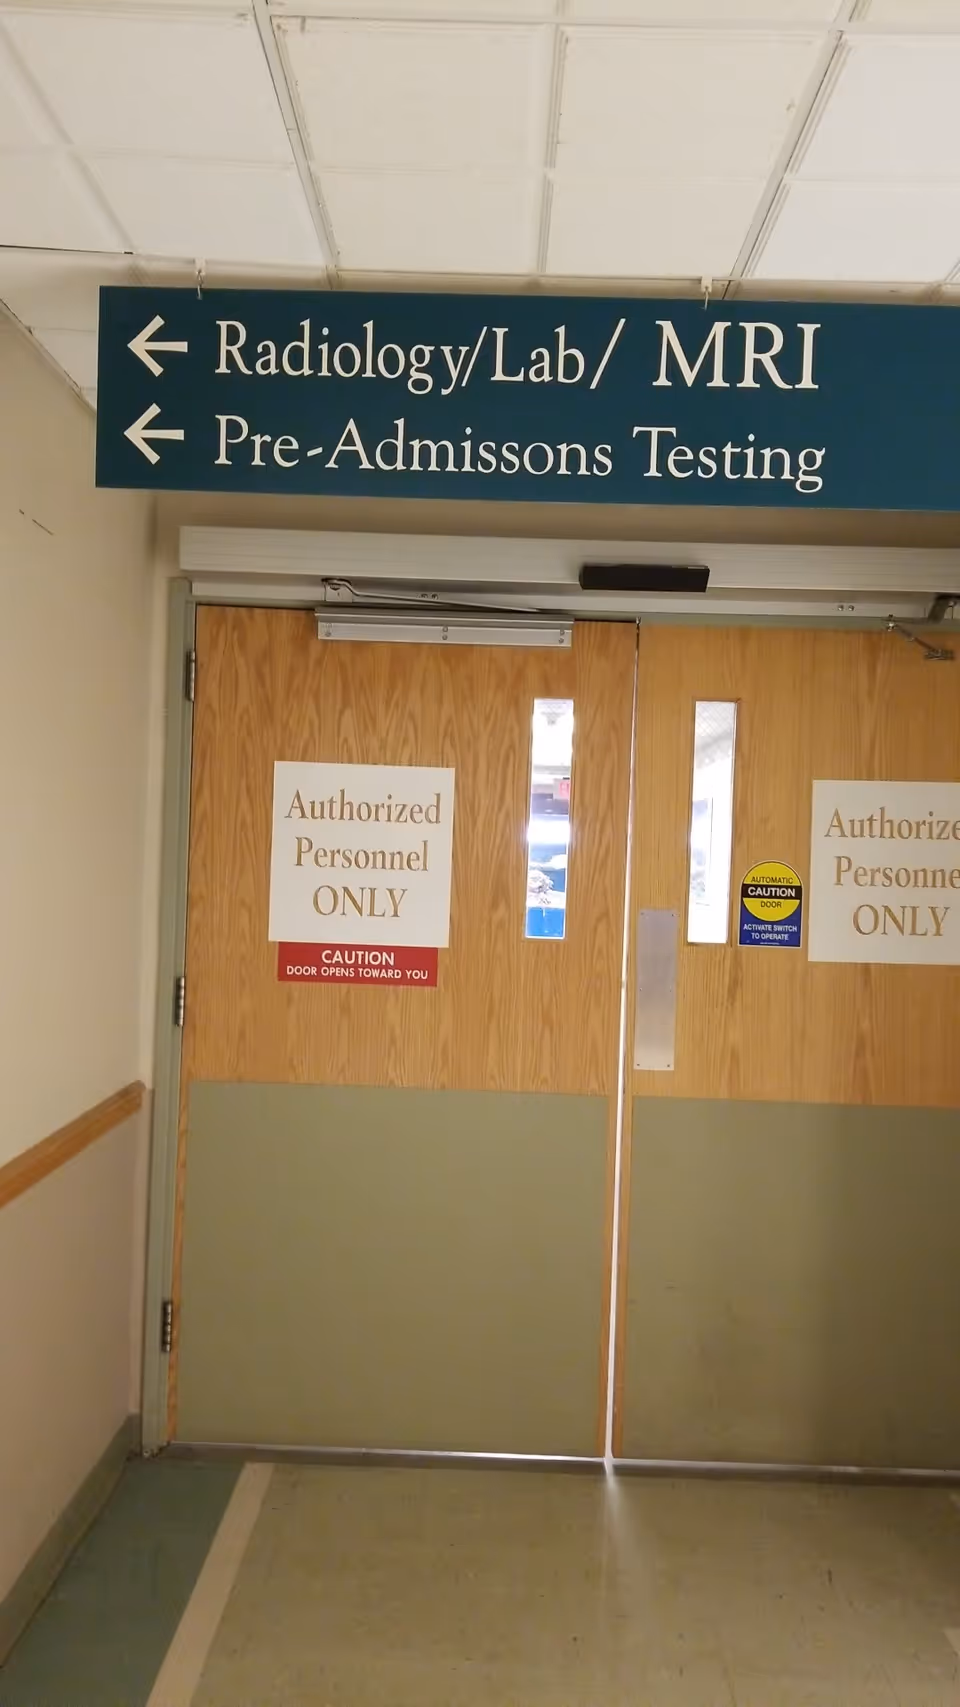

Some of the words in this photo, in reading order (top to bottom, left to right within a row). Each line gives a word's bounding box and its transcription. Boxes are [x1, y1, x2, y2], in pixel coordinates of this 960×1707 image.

[652, 319, 821, 390] MRI
[214, 414, 613, 476] Pre-Admissons
[632, 426, 826, 493] Testing
[284, 788, 441, 825] Authorized
[294, 836, 429, 872] Personnel
[751, 876, 794, 885] AUTOMATIC
[833, 855, 960, 889] Personne
[312, 885, 408, 918] ONLY
[747, 886, 796, 898] CAUTION
[760, 901, 782, 909] DOOR
[743, 923, 772, 932] ACTIVATE
[773, 924, 798, 933] SWITCH
[852, 904, 951, 937] ONLY
[751, 932, 760, 940] TO
[760, 933, 789, 941] OPERATE
[321, 950, 395, 966] CAUTION
[286, 965, 317, 976] DOOR
[321, 966, 355, 977] OPENS
[358, 967, 402, 979] TOWARD
[405, 969, 428, 980] YOU
